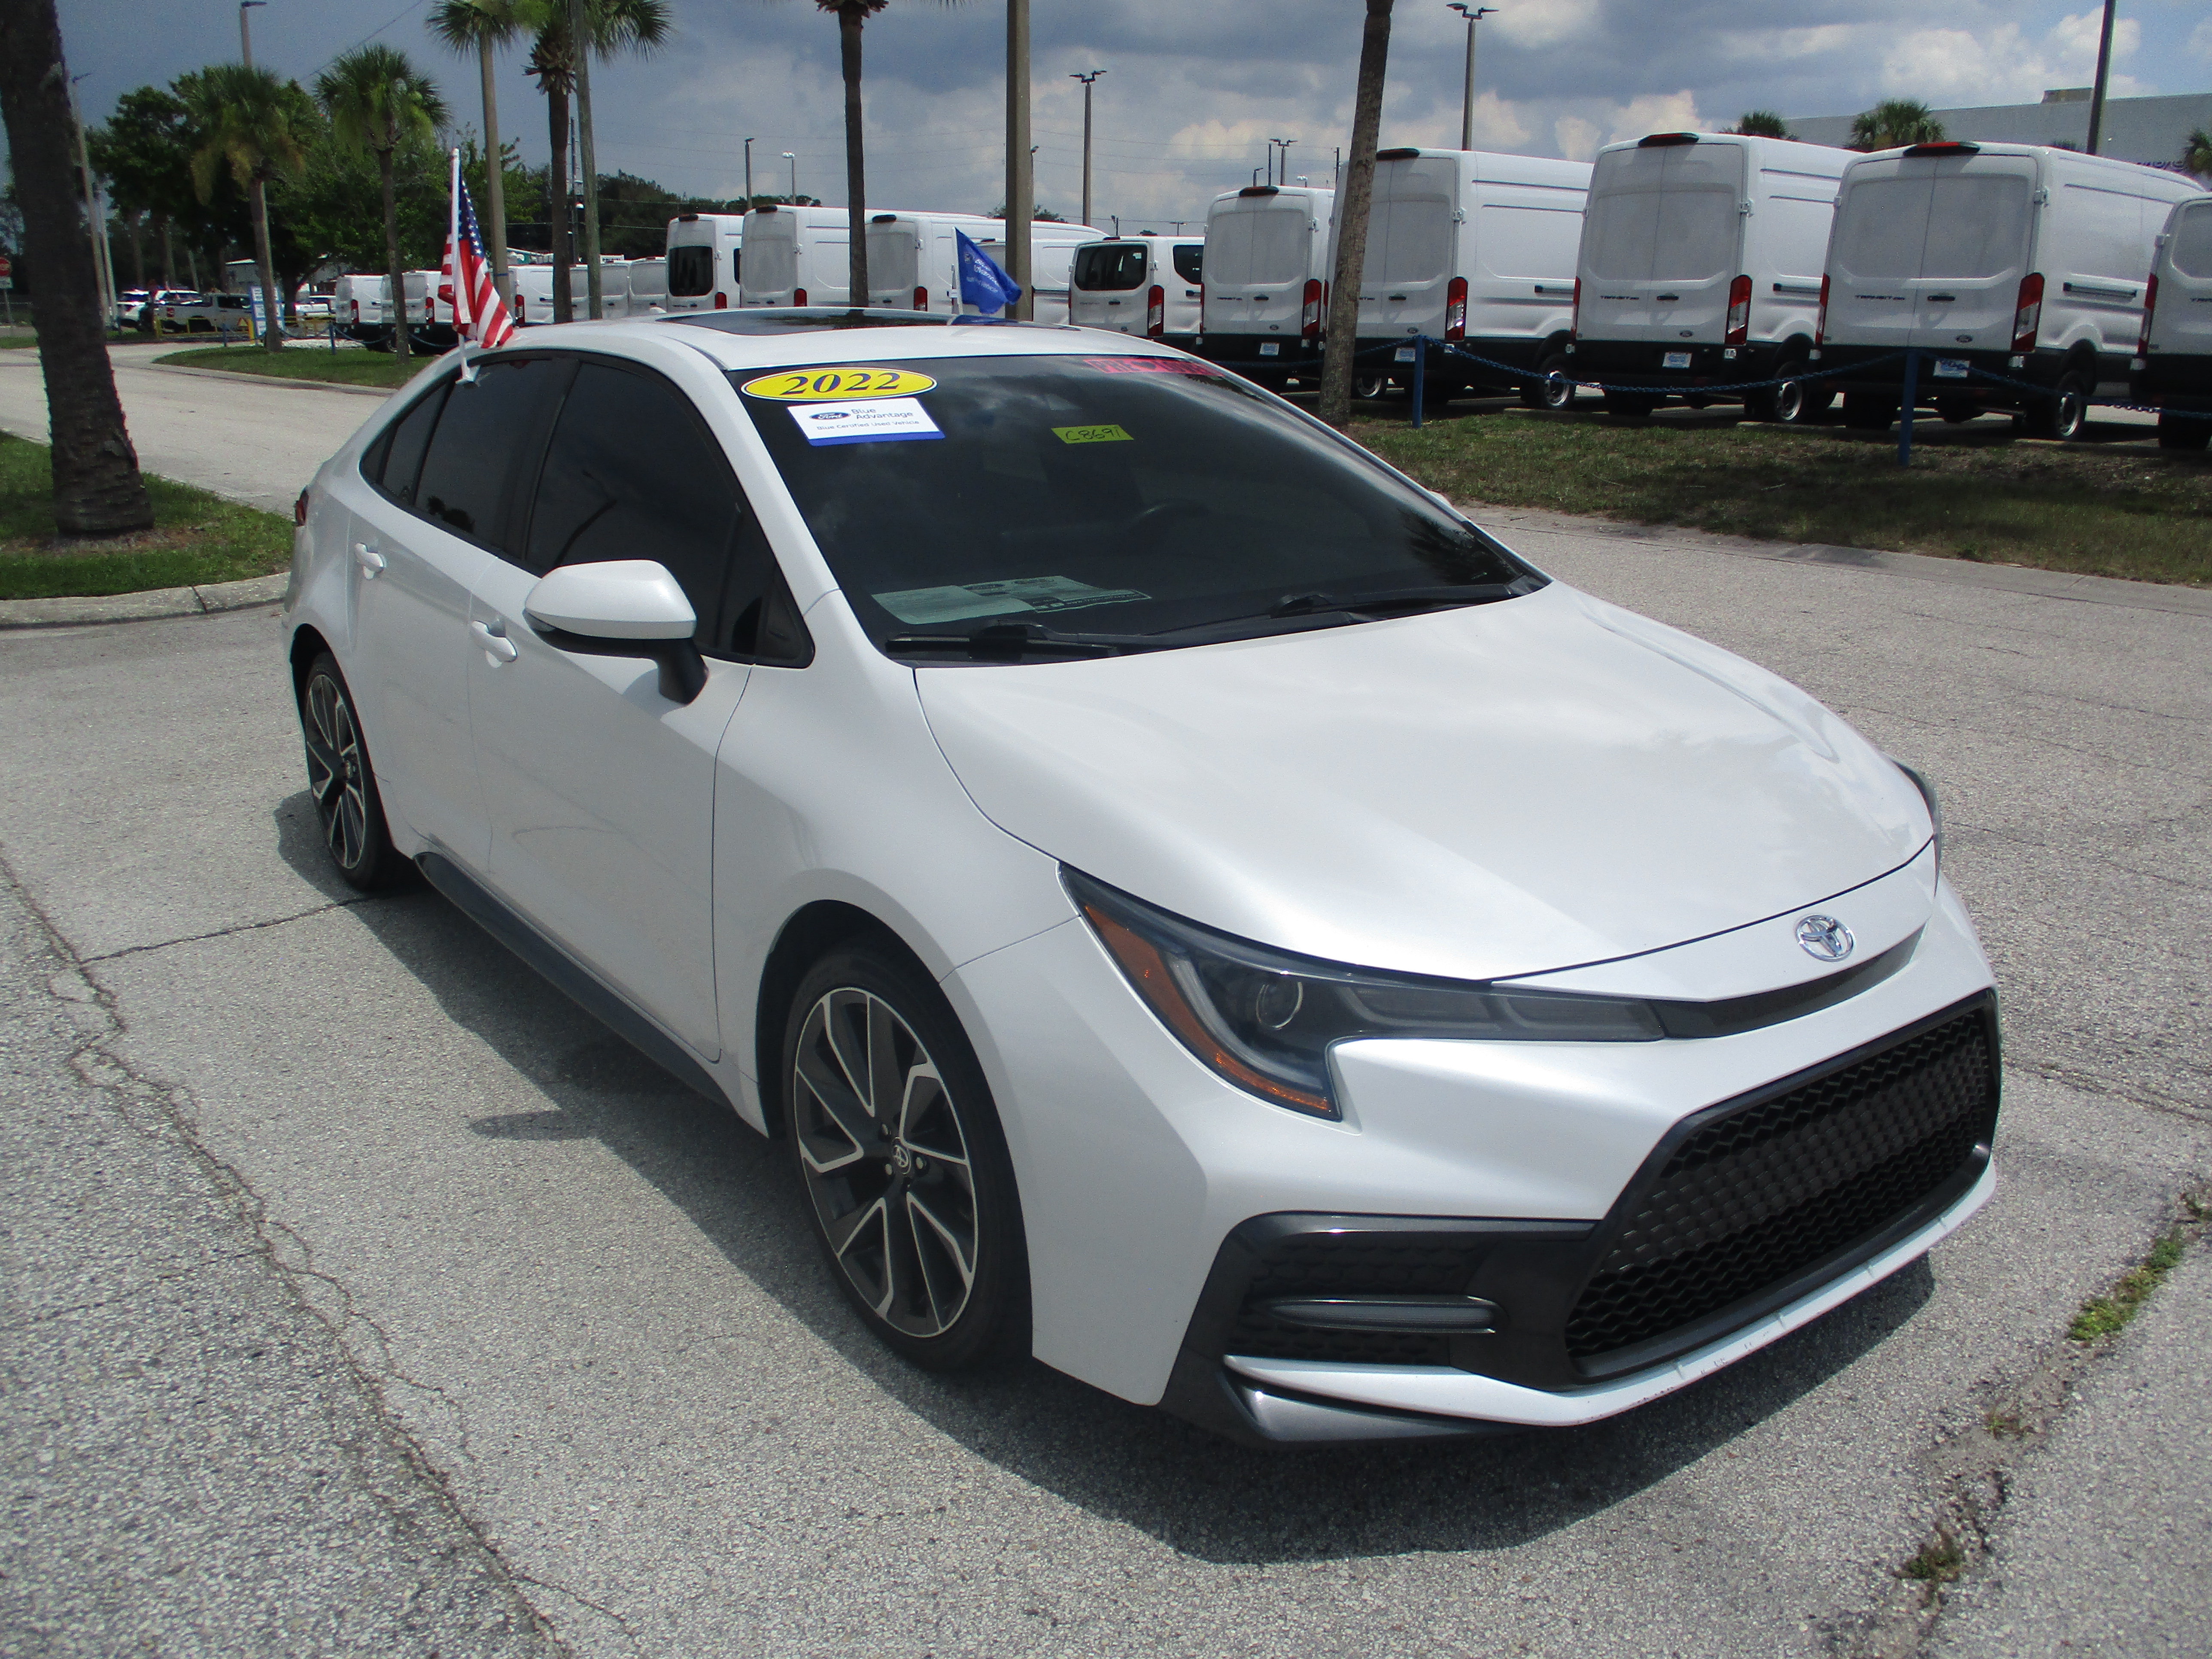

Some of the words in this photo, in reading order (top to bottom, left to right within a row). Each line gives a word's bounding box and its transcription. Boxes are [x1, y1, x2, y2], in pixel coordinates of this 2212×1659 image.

[780, 372, 900, 395] 2022
[857, 411, 914, 419] Advantage
[1066, 428, 1121, 441] C8691
